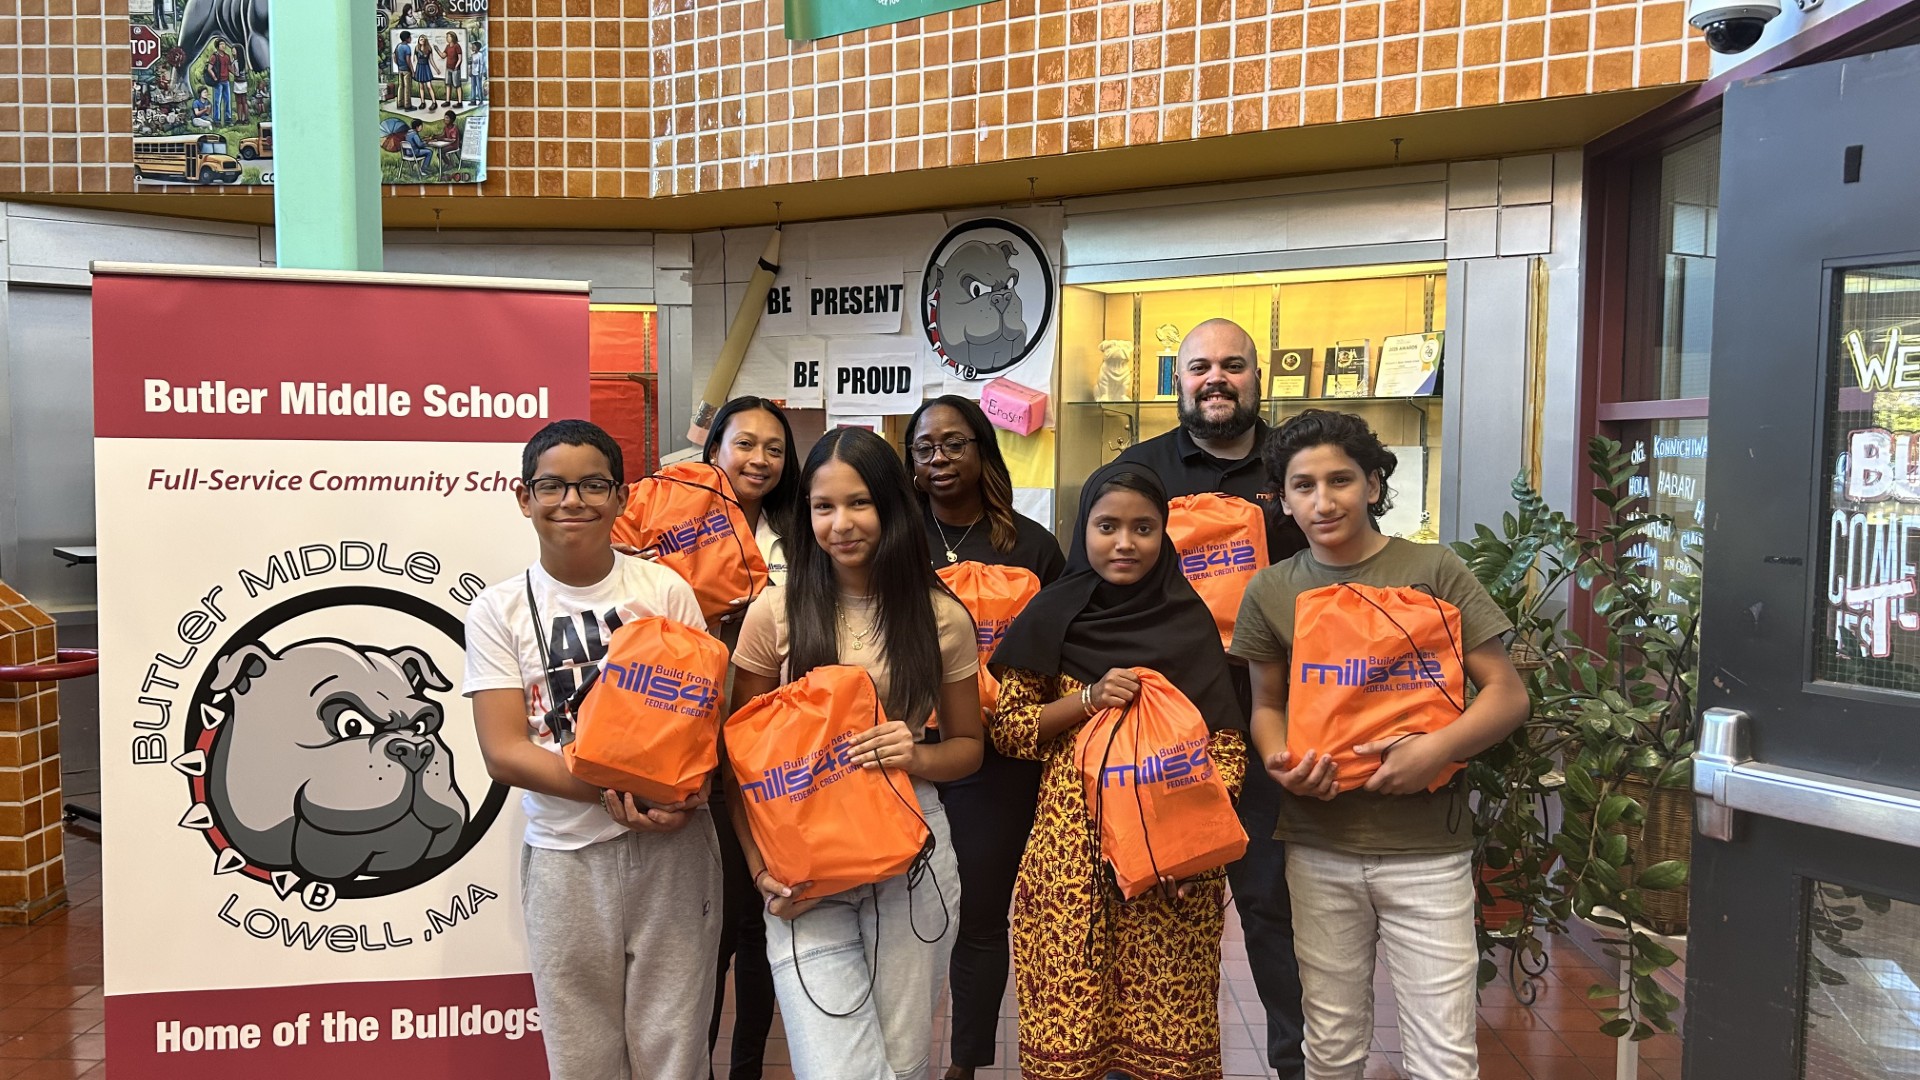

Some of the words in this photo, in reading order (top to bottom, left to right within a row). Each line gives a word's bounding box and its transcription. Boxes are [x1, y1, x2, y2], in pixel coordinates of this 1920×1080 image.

[767, 286, 792, 315] BE
[810, 284, 904, 316] PRESENT
[793, 360, 820, 388] BE
[837, 365, 912, 395] PROUD
[966, 367, 976, 380] B
[144, 378, 269, 415] Butler
[280, 381, 411, 417] Middle
[423, 383, 549, 419] School
[987, 398, 1024, 423] Eraser
[148, 467, 303, 491] Full-Service
[309, 469, 460, 498] Community
[1628, 476, 1650, 497] HOLA
[1657, 469, 1696, 501] HABARI
[672, 518, 693, 533] Build
[701, 534, 720, 548] CREDIT
[1181, 545, 1205, 556] Build
[1206, 543, 1228, 552] from
[1230, 538, 1253, 547] here.
[1186, 572, 1213, 581] FEDERAL
[1213, 567, 1235, 577] CREDIT
[1237, 563, 1257, 573] UNION
[1369, 655, 1394, 666] Build
[655, 664, 684, 680] Build
[686, 671, 712, 687] from
[1301, 658, 1446, 687] mills42
[1396, 681, 1422, 691] CREDIT
[644, 697, 678, 713] FEDERAL
[783, 755, 811, 771] Build
[810, 744, 831, 761] from
[1159, 742, 1186, 758] Build
[789, 785, 820, 804] FEDERAL
[819, 769, 845, 788] CREDIT
[1166, 774, 1200, 790] FEDERAL
[311, 883, 330, 907] B
[156, 1019, 261, 1053] Home
[272, 1012, 311, 1047] of
[321, 1010, 380, 1044] the
[391, 1004, 543, 1041] Bulldogs
